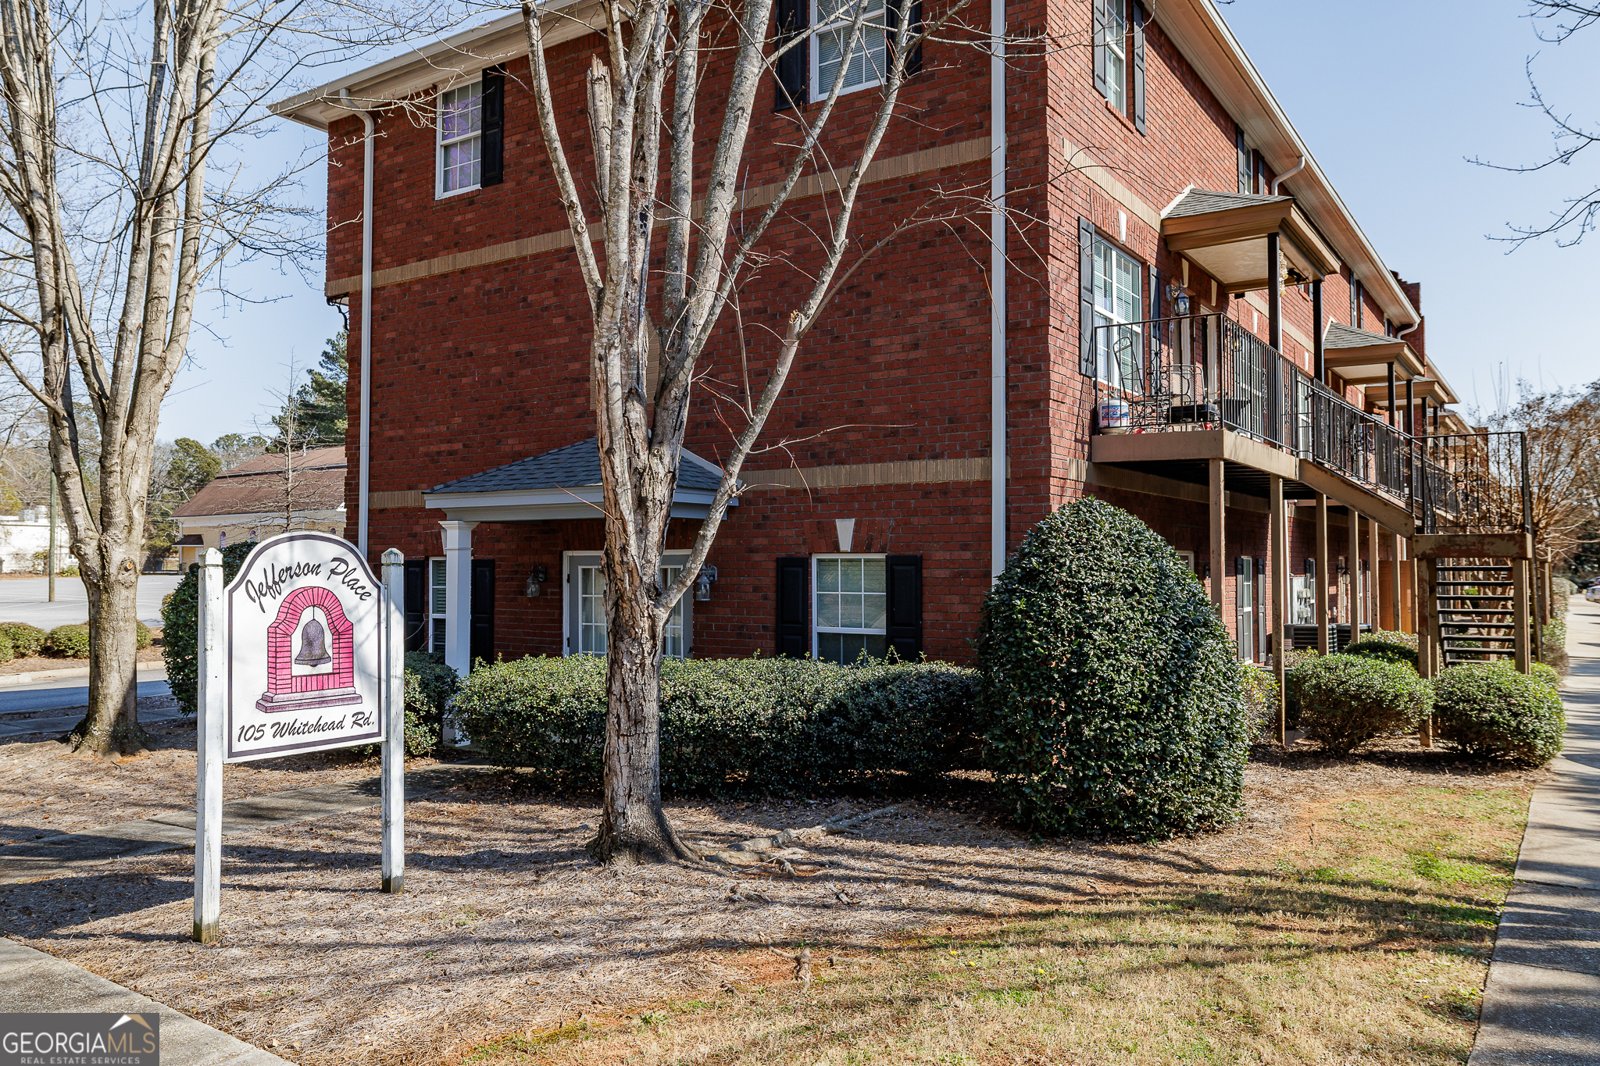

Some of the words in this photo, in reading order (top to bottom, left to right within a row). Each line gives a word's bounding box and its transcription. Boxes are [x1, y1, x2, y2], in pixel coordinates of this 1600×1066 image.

[245, 560, 322, 613] Jefferson
[326, 557, 372, 601] Place
[237, 723, 266, 743] 105
[270, 714, 345, 739] Whitehead
[350, 711, 375, 732] Rd.
